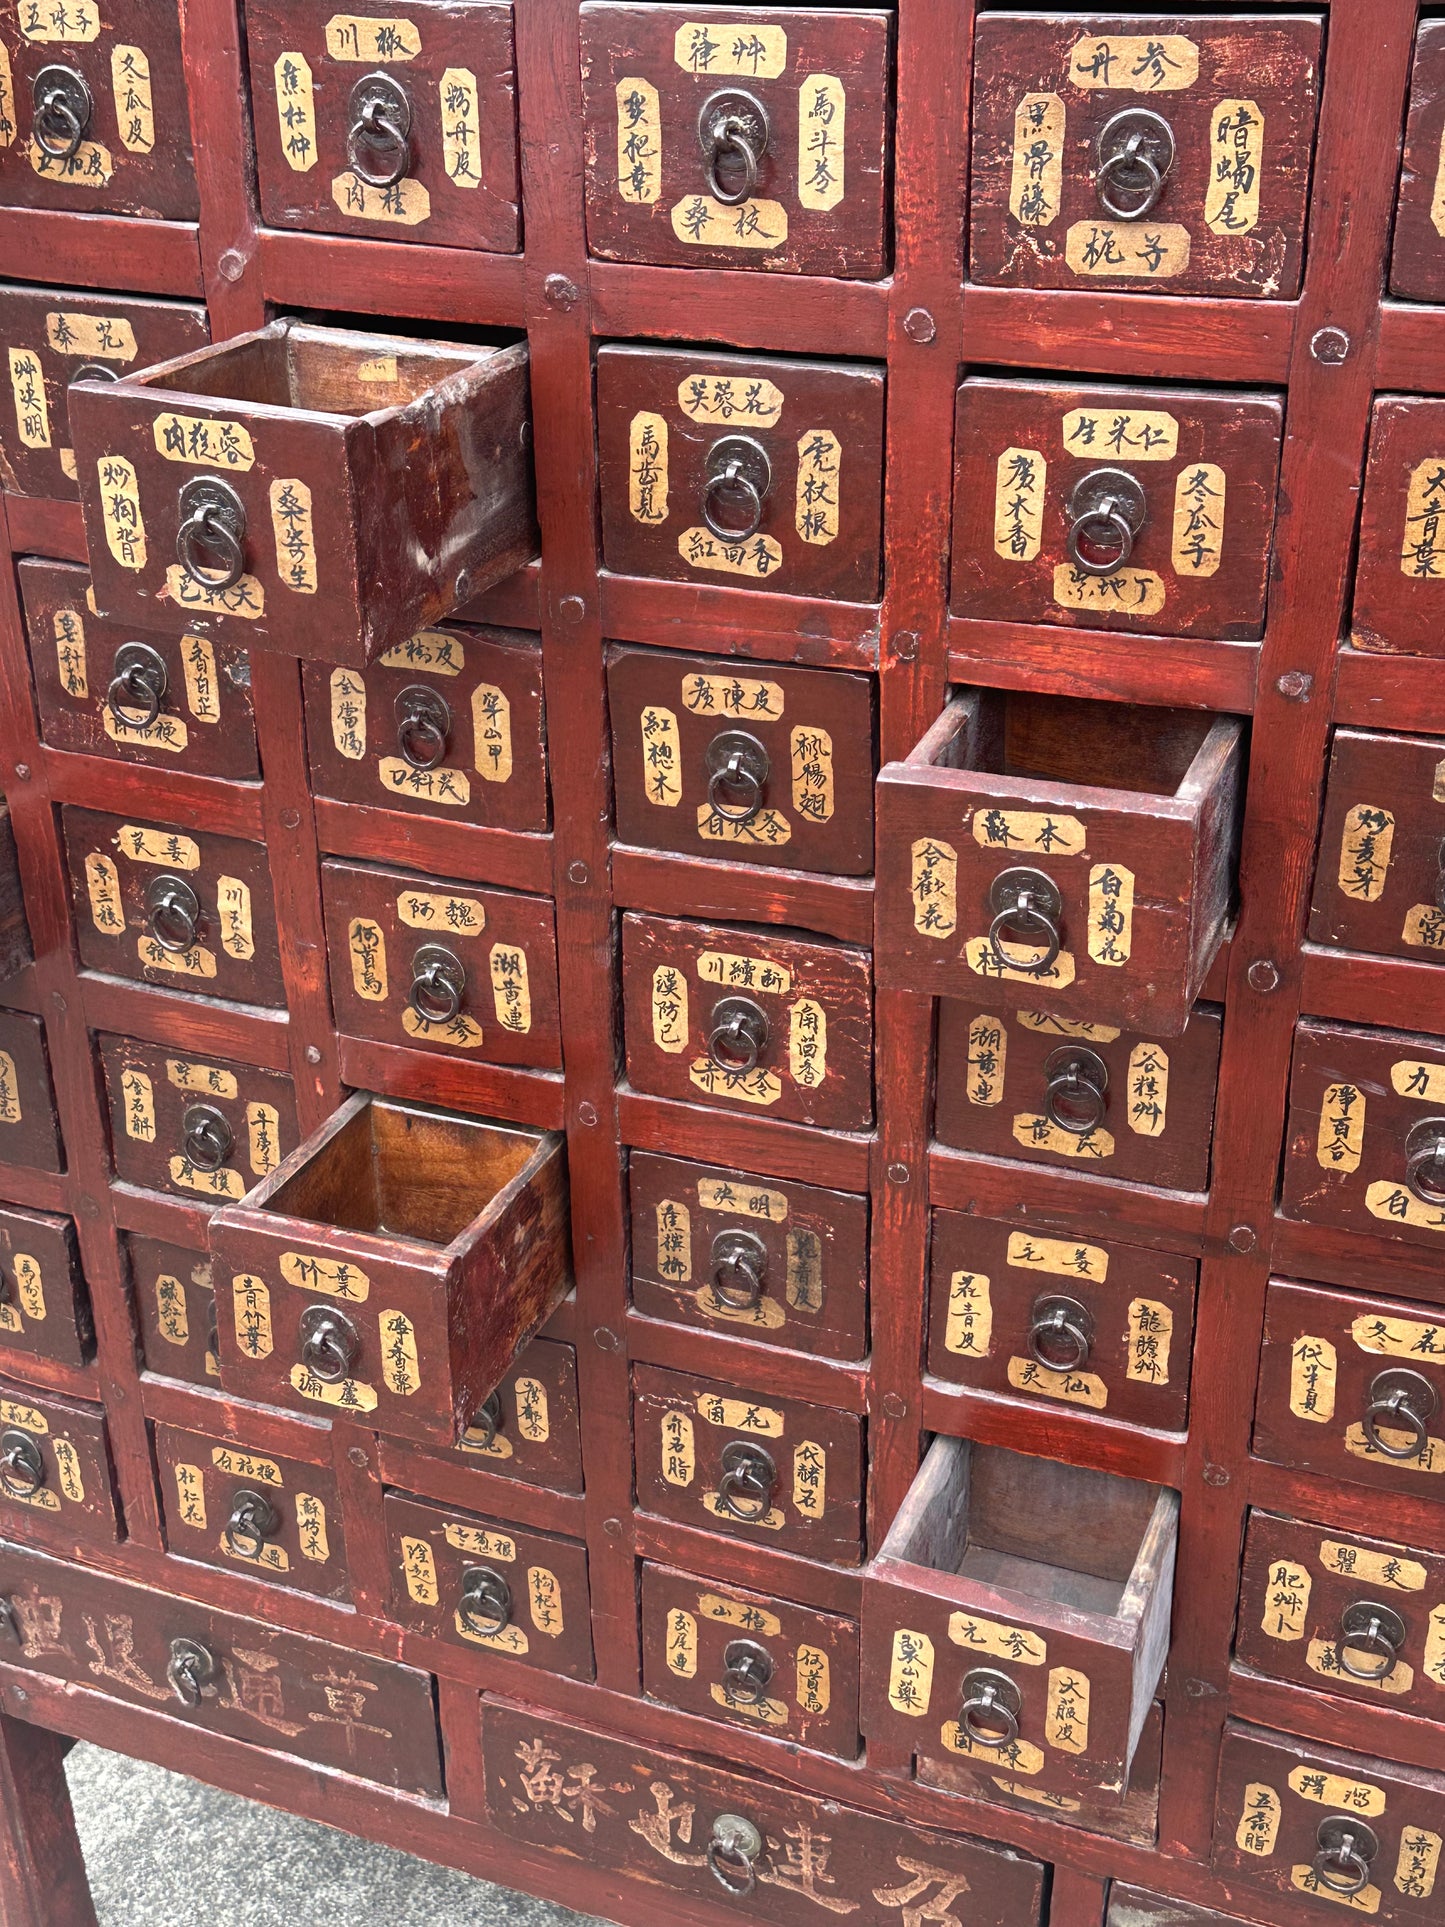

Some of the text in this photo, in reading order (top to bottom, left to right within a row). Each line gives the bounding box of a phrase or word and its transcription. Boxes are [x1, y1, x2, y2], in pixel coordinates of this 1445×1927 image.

[25, 2, 92, 37] 五味子
[120, 53, 151, 147] 冬瓜皮
[1181, 469, 1224, 568] 冬瓜子
